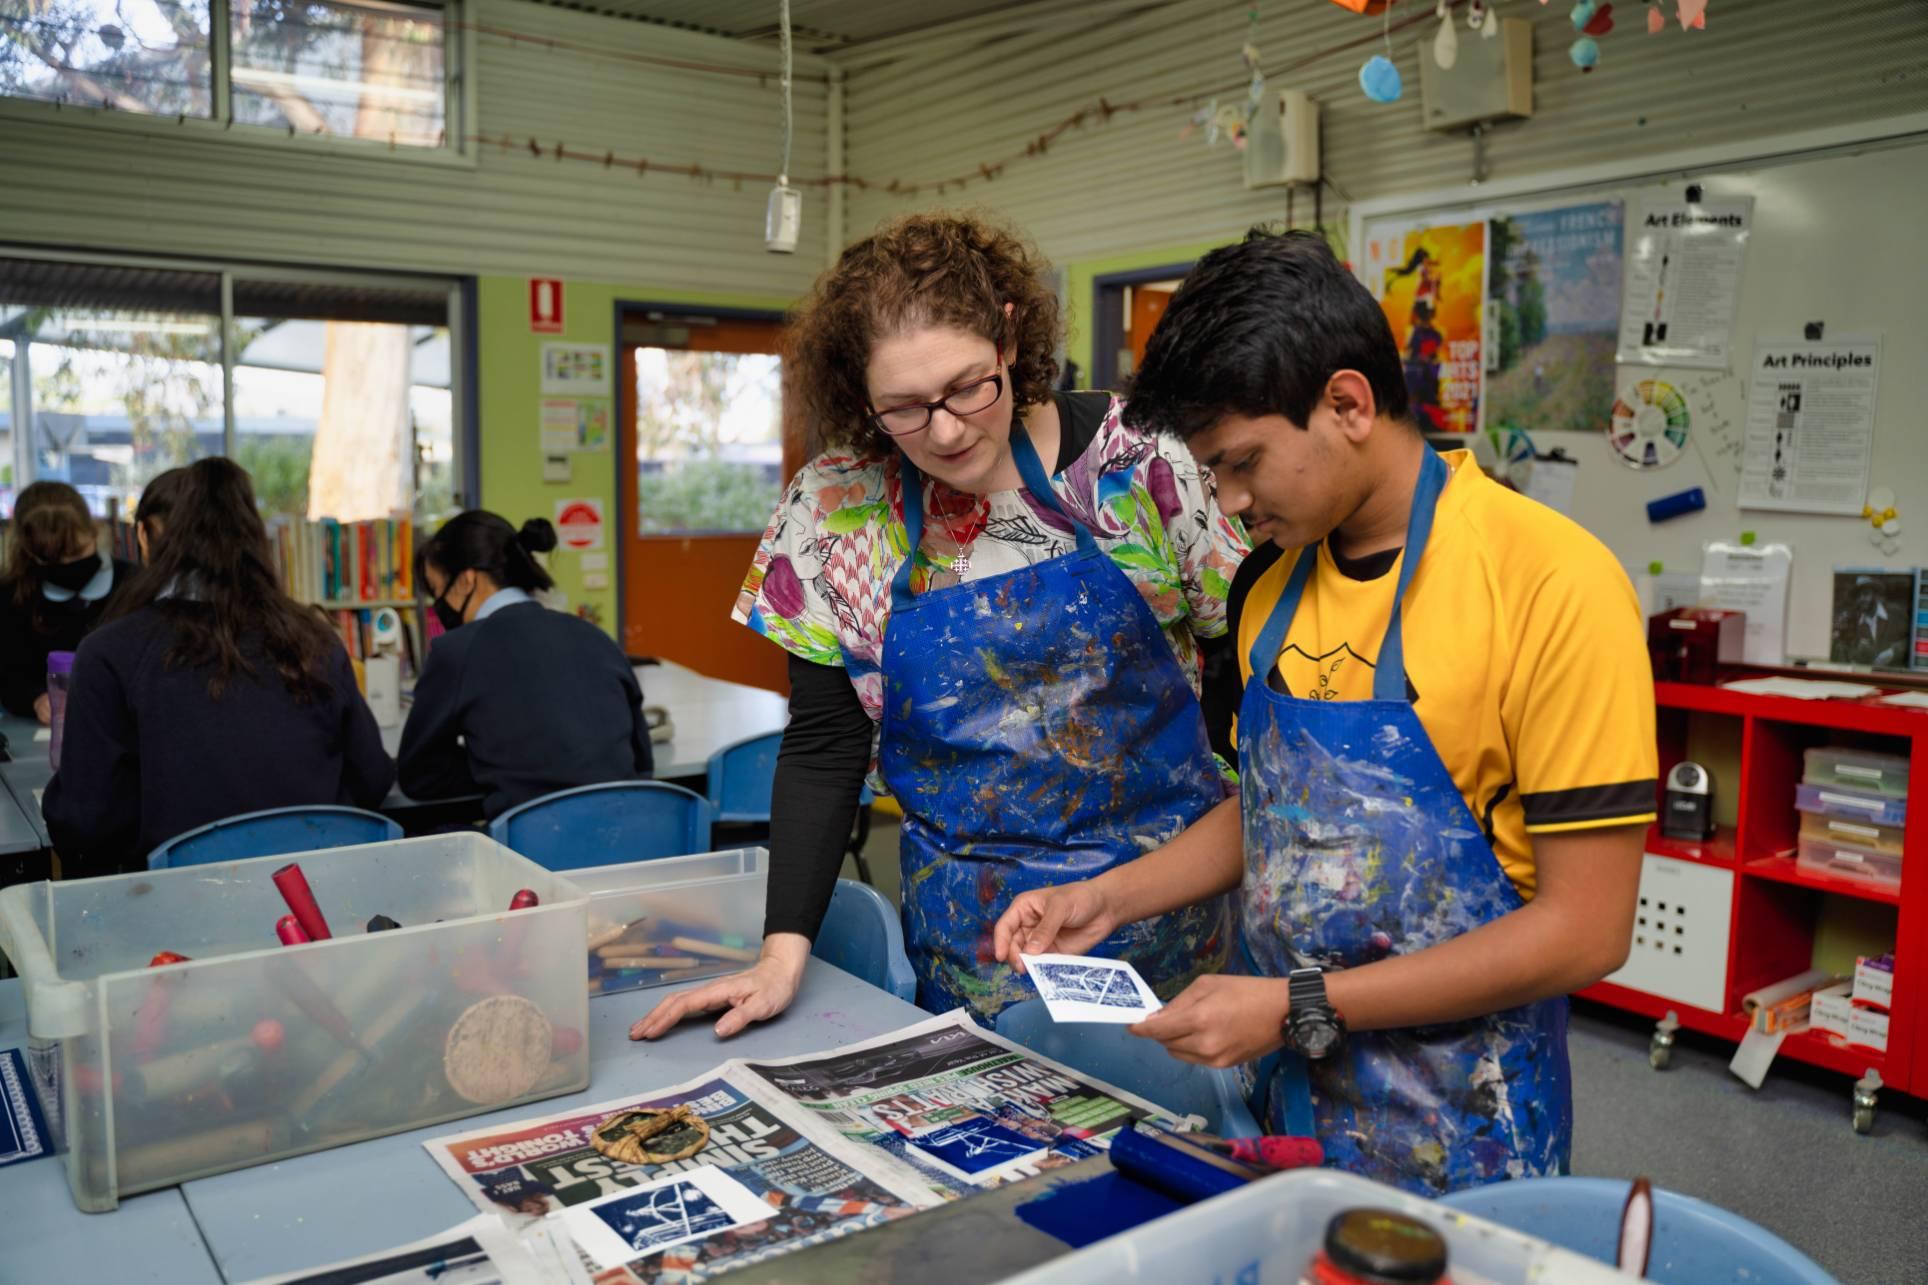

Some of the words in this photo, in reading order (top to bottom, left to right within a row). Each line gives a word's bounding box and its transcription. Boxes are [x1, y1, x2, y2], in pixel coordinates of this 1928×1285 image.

[1645, 213, 1668, 228] Art
[1671, 212, 1743, 228] Elements
[1448, 340, 1479, 361] TOP
[1763, 354, 1787, 368] Art
[1791, 351, 1872, 371] Principles
[466, 1129, 581, 1162] TONIGHT
[470, 1139, 586, 1169] WORLD'S
[587, 1137, 781, 1193] SIMPLY
